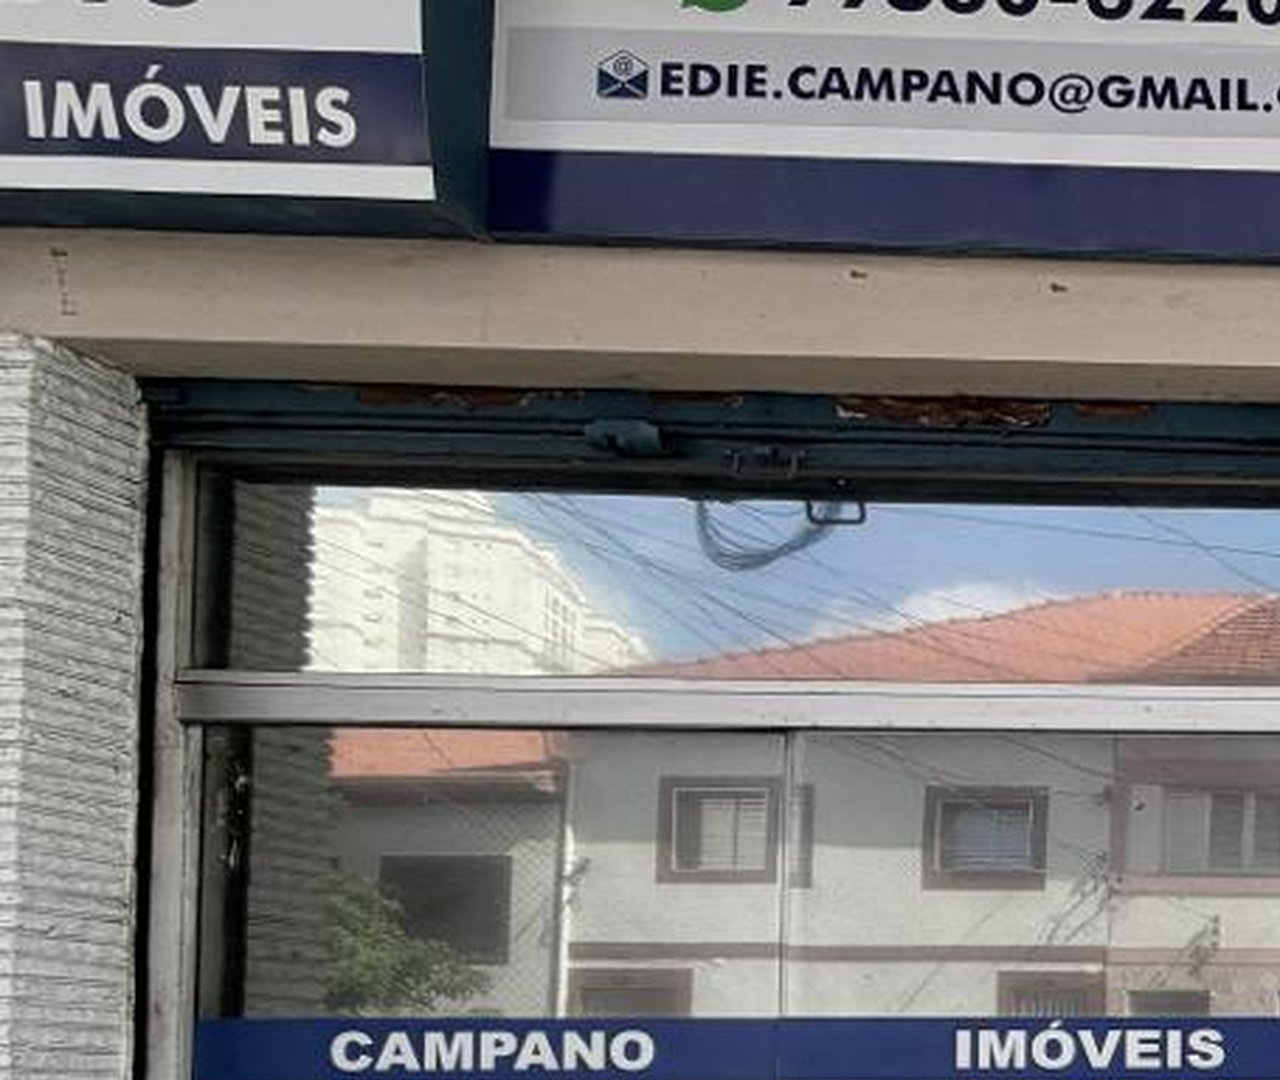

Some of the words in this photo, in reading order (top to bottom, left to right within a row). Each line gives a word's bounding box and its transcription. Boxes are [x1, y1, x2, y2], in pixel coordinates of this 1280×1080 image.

[22, 64, 358, 148] IMÓVEIS
[329, 1030, 655, 1072] CAMPANO
[954, 1021, 1226, 1070] IMÓVEIS
